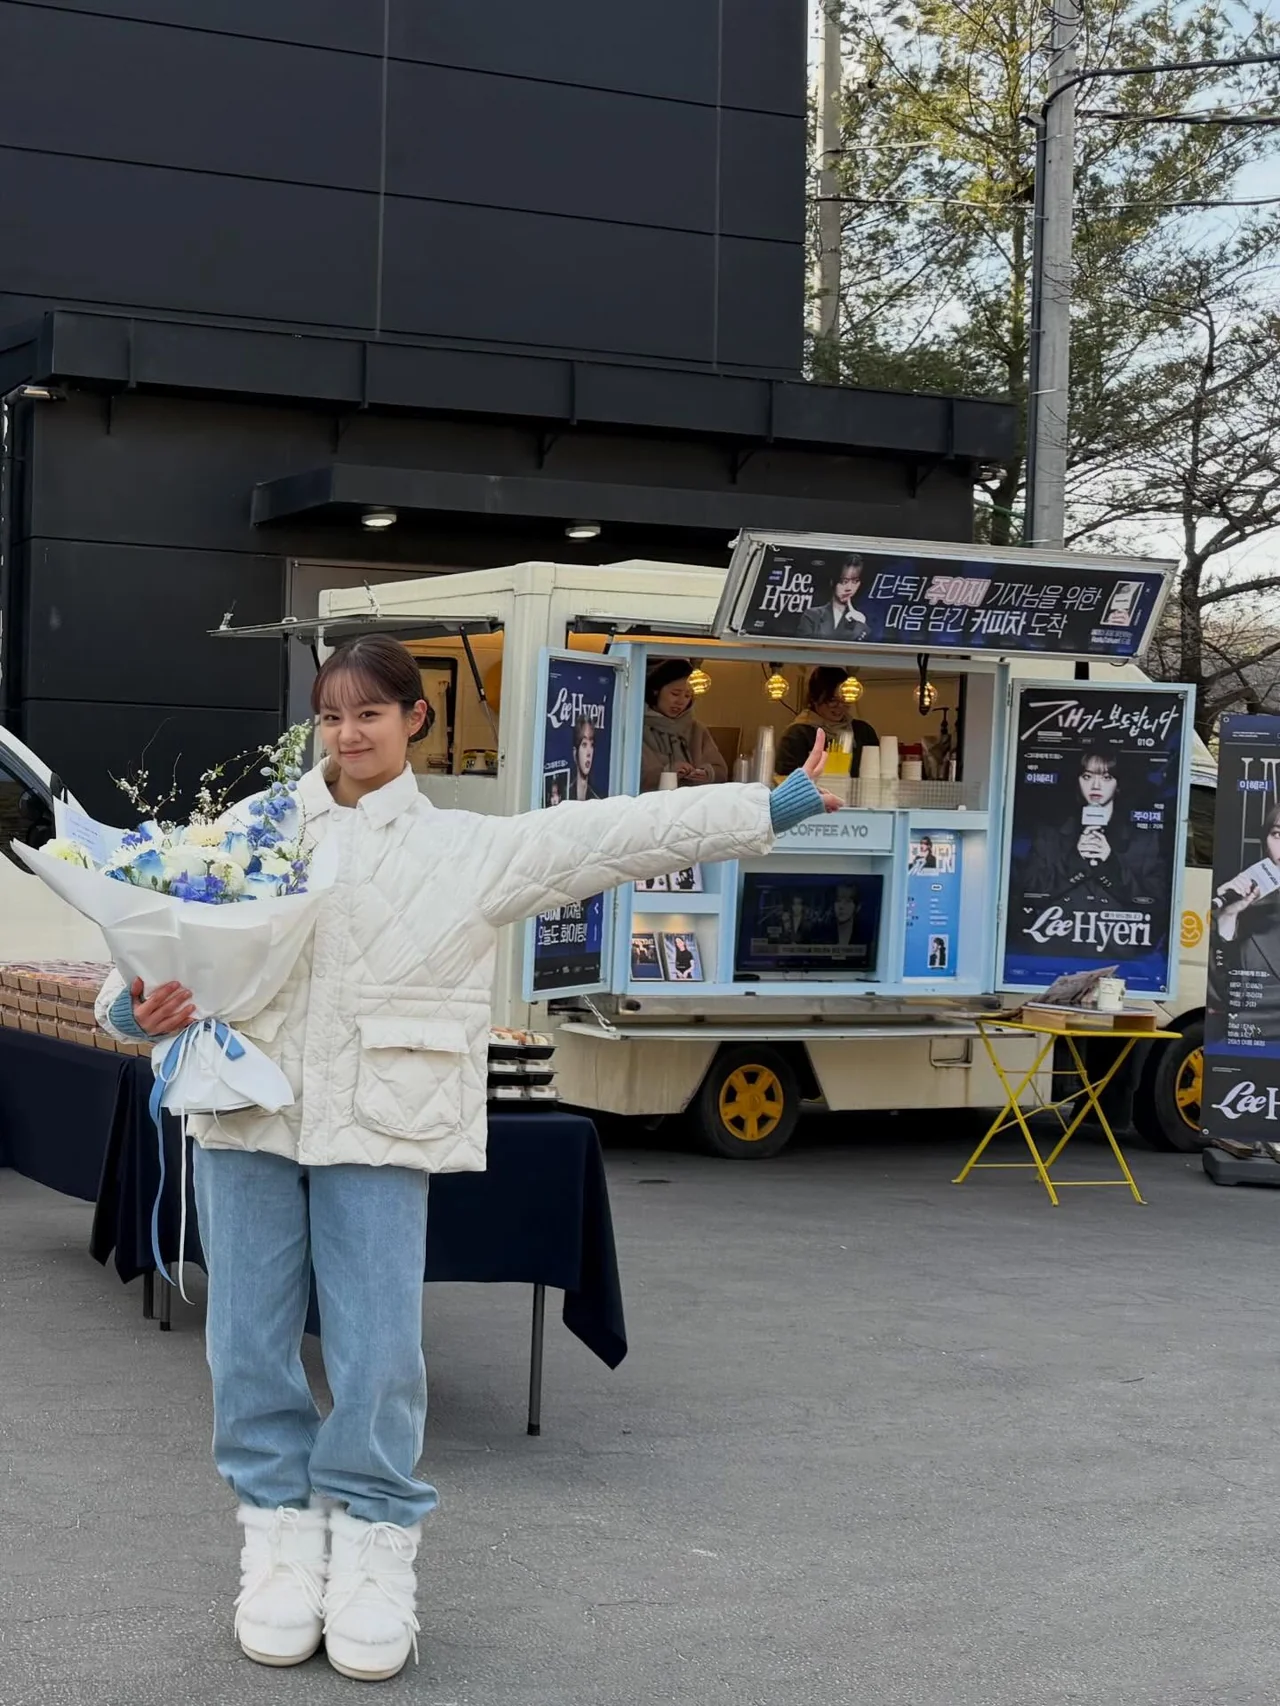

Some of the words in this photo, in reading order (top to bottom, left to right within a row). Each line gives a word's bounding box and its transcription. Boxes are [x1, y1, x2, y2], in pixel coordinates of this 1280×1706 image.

[759, 585, 814, 618] Hyeri
[868, 573, 928, 602] [단독]
[925, 576, 991, 607] 주이재
[986, 582, 1064, 609] 기자님을
[1062, 586, 1103, 611] 위한
[885, 604, 927, 631] 마음
[928, 607, 969, 633] 담긴
[969, 608, 1028, 636] 커피차
[1028, 612, 1068, 640] 도착
[547, 687, 572, 728] Lee
[1102, 703, 1180, 741] 보도합니다
[790, 823, 839, 837] COFFEE
[538, 925, 560, 946] 오늘도
[560, 922, 589, 943] 화이팅!
[1022, 906, 1074, 943] Lee
[1071, 910, 1152, 953] Hyeri
[1211, 1081, 1267, 1119] Lee
